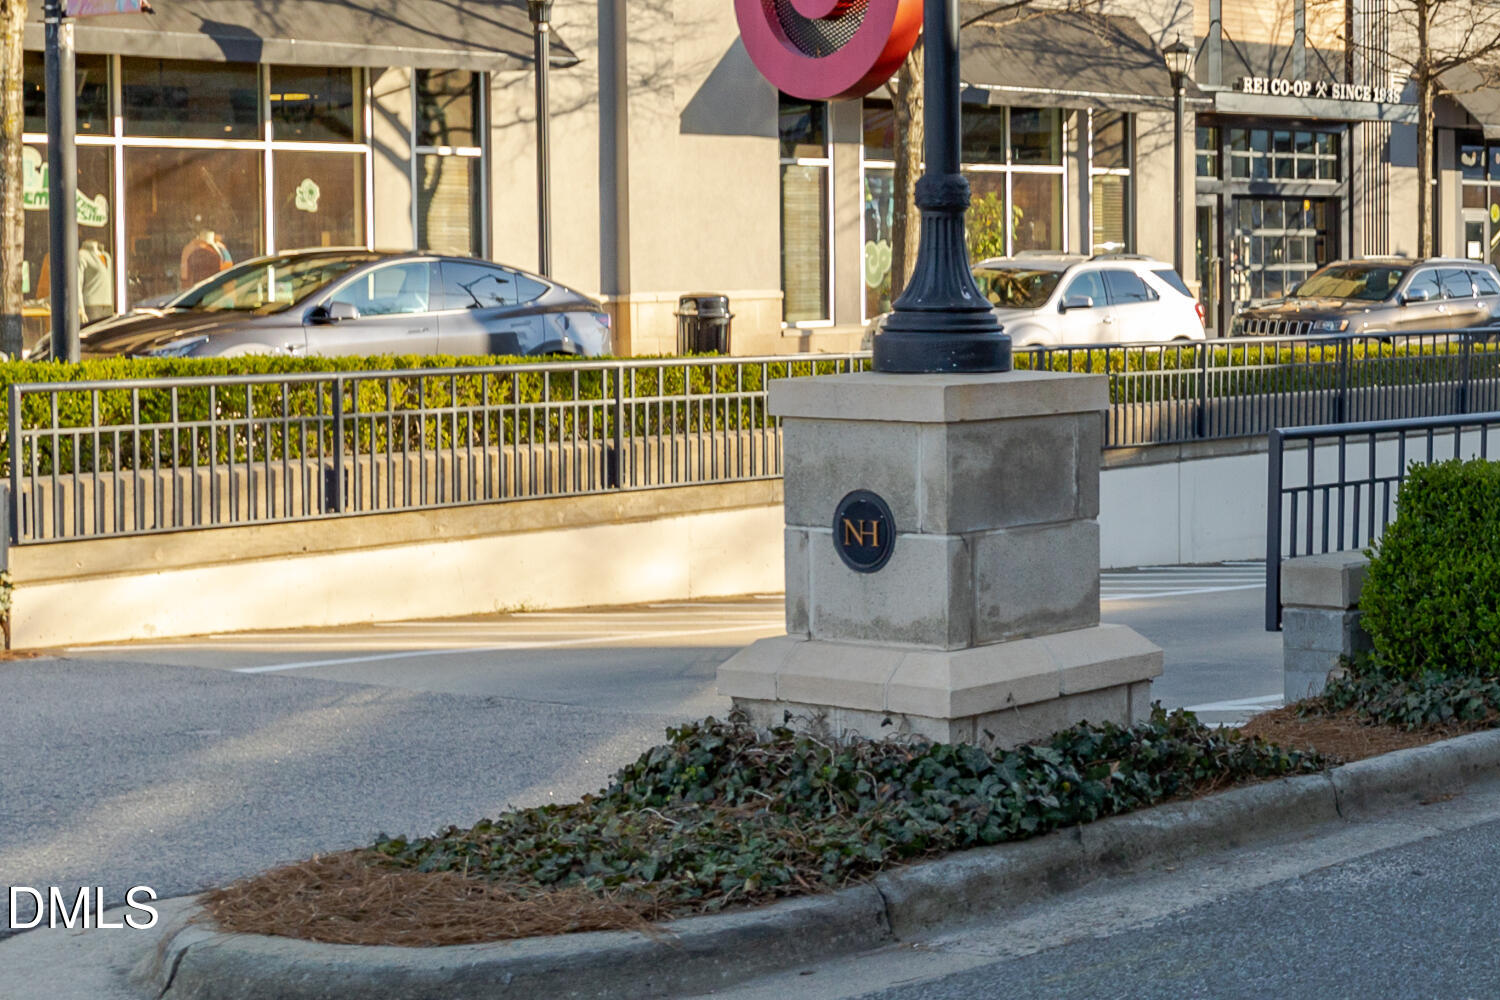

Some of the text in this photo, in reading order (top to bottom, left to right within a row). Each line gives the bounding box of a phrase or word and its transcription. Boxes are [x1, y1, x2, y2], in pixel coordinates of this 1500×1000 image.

[1242, 76, 1269, 95] REI
[1331, 83, 1371, 102] SINCE
[843, 518, 881, 548] NH
